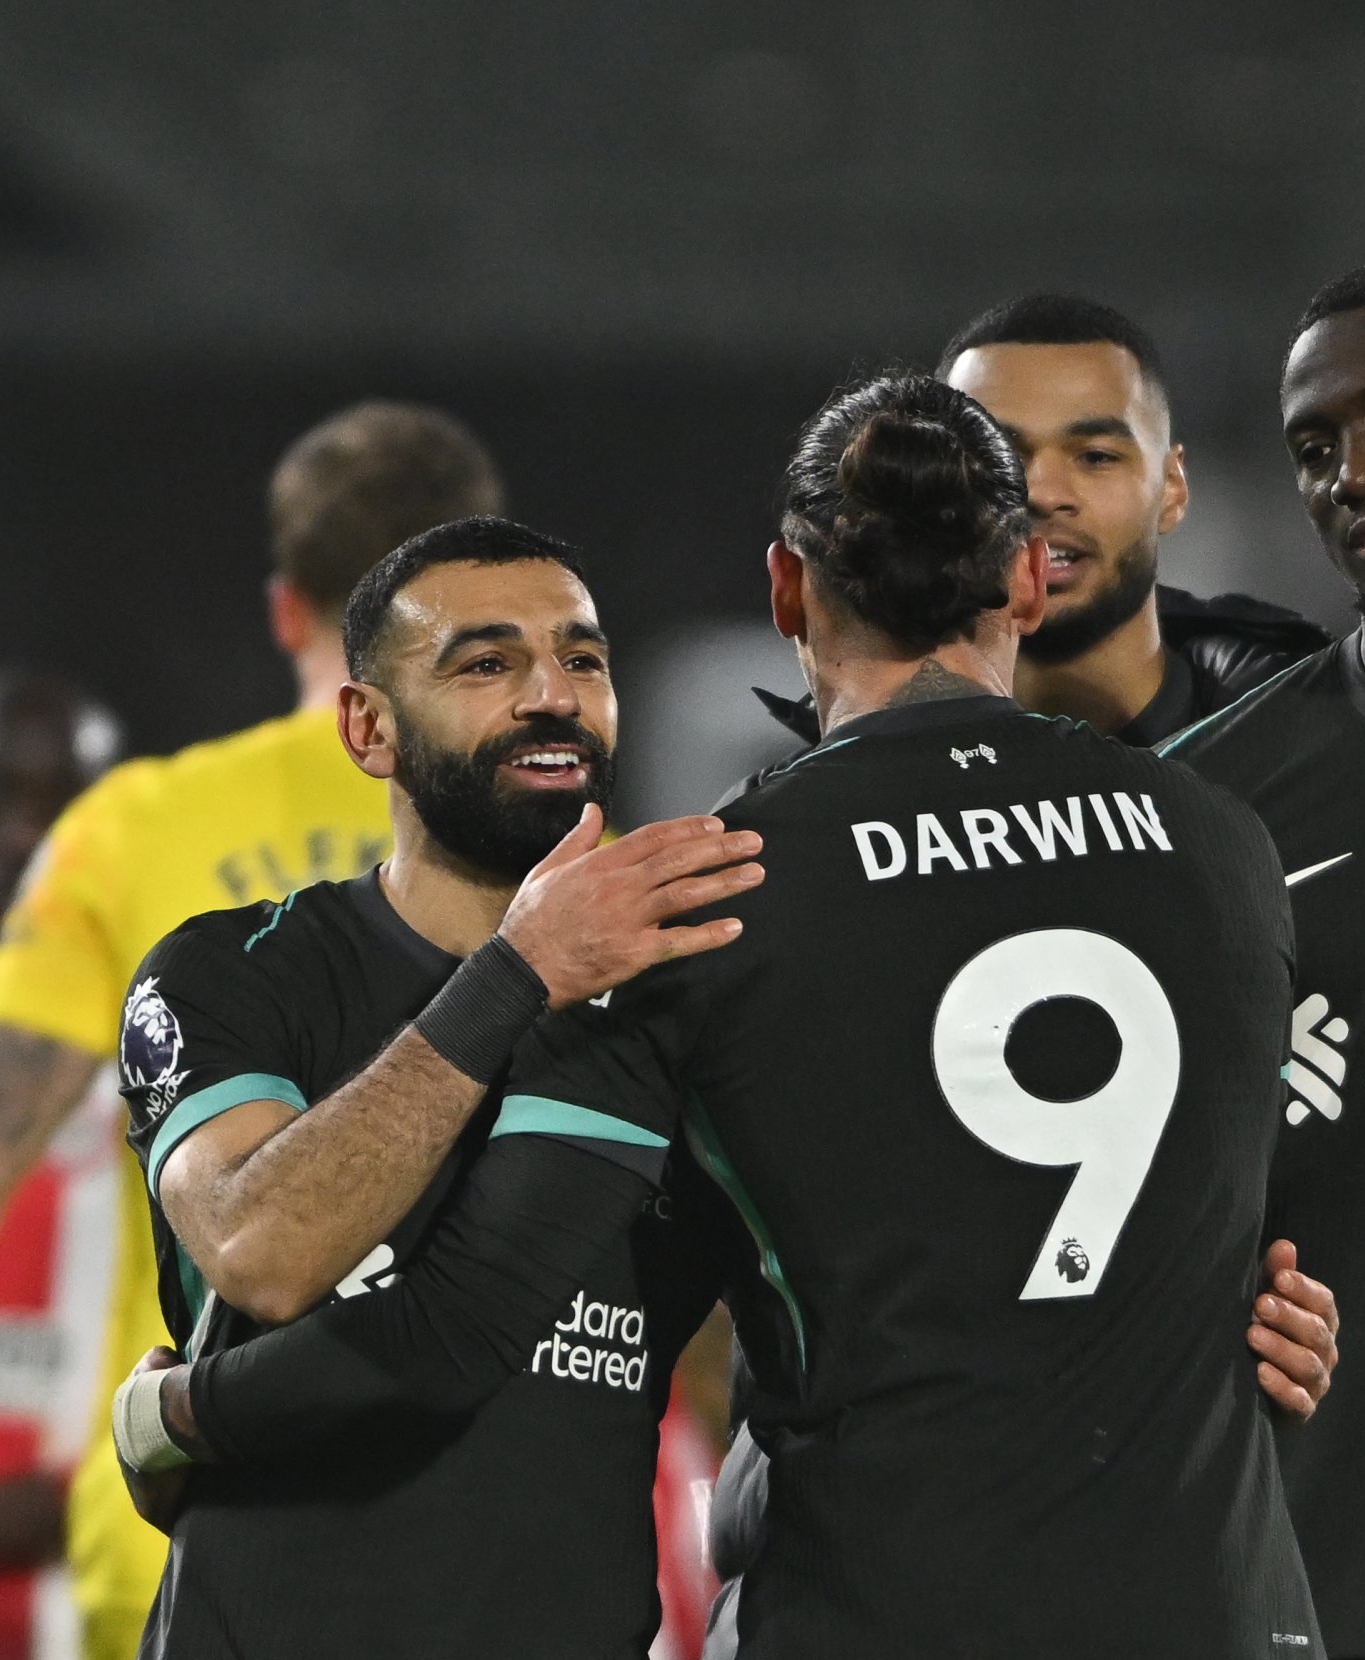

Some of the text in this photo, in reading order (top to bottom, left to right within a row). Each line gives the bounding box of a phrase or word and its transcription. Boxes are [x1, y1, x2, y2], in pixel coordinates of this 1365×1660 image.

[851, 792, 1174, 882] DARWIN
[931, 927, 1181, 1300] 9
[554, 1290, 645, 1346] dard
[531, 1332, 649, 1392] rtered
